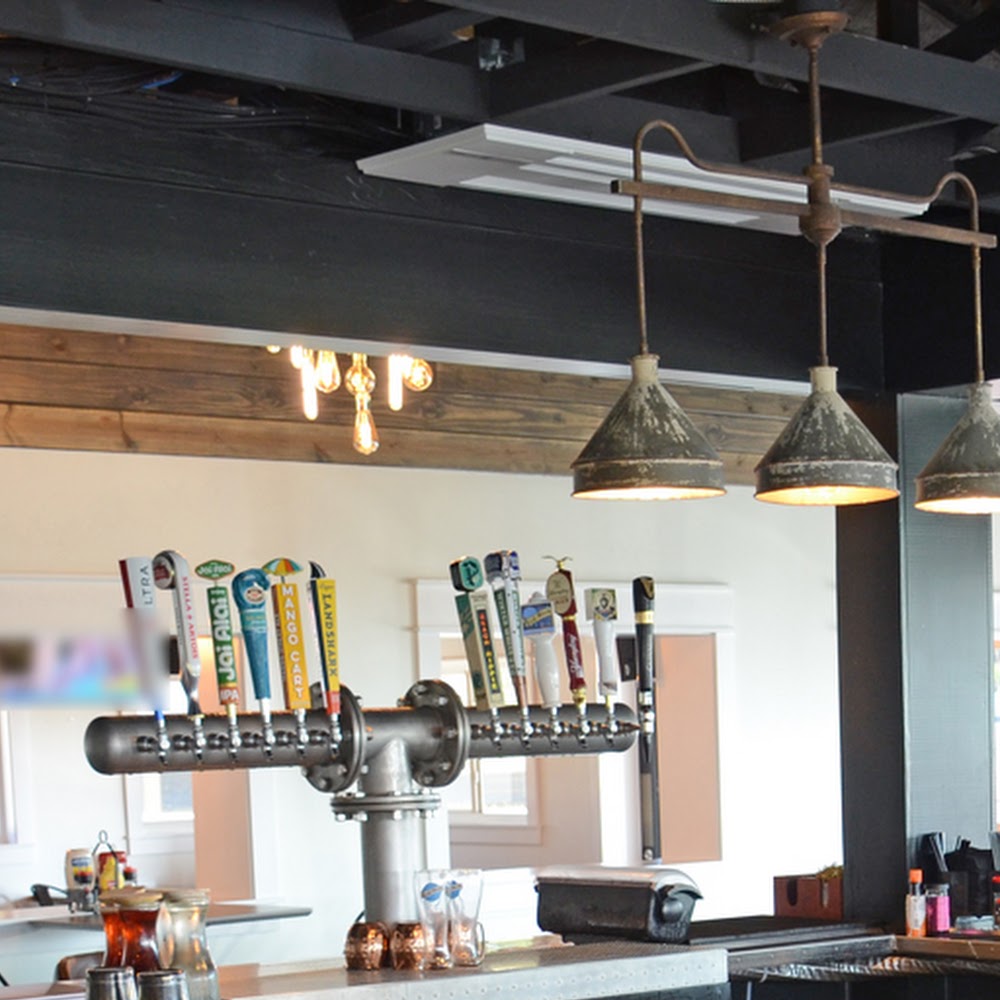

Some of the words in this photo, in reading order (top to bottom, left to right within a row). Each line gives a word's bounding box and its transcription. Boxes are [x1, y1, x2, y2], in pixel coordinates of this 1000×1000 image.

[211, 596, 231, 642] Alai
[282, 586, 299, 646] MANGO
[322, 593, 338, 677] LANDSHARK
[216, 645, 236, 681] Jai
[290, 651, 304, 698] CART
[221, 689, 239, 701] IPA
